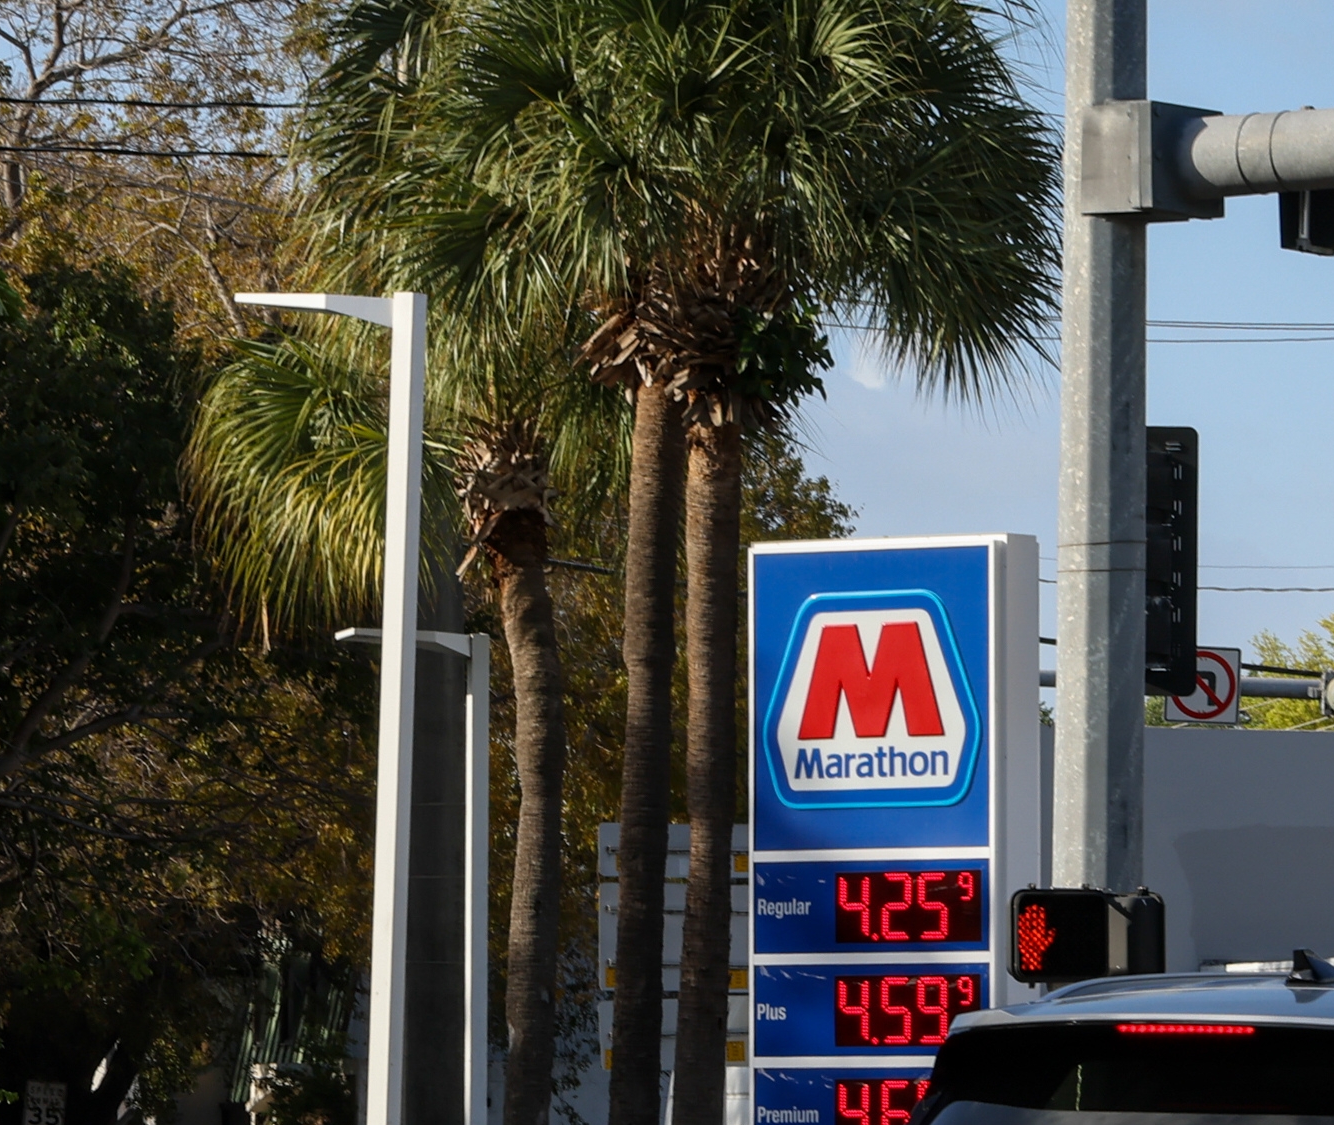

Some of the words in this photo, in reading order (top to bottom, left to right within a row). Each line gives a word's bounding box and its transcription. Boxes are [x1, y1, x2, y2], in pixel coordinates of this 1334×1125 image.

[798, 621, 945, 740] M
[794, 745, 950, 780] Marathon
[756, 898, 812, 919] Regular
[756, 1003, 787, 1021] Plus
[756, 1105, 820, 1124] Premium
